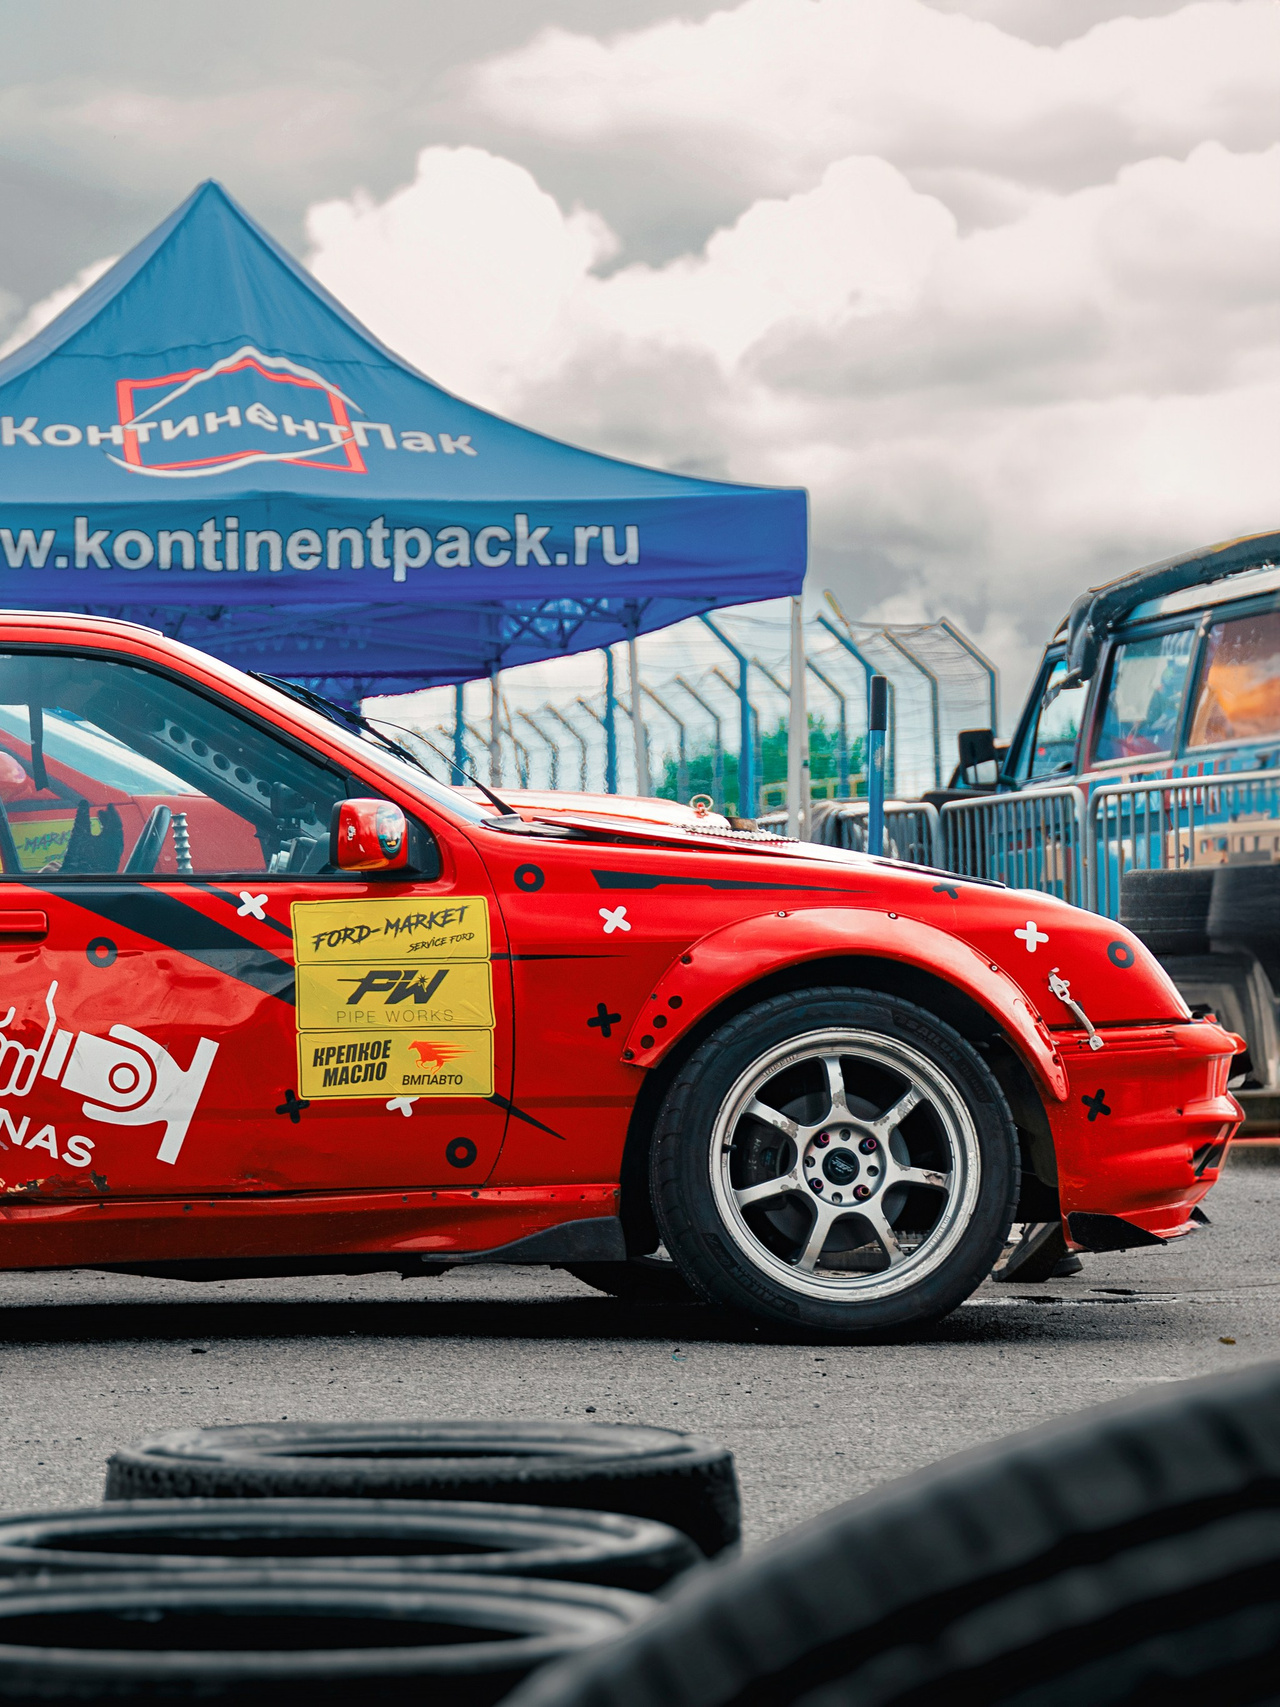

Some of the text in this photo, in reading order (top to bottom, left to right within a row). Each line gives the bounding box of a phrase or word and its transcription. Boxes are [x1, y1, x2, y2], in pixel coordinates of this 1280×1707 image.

[311, 905, 470, 952] FORD-MARKET
[450, 932, 475, 945] FORD
[336, 1009, 454, 1023] PIPE WORKS
[312, 1039, 392, 1067] КРЕПКОЕ
[322, 1061, 388, 1087] МАСЛО
[401, 1074, 463, 1086] ВМПАВТО
